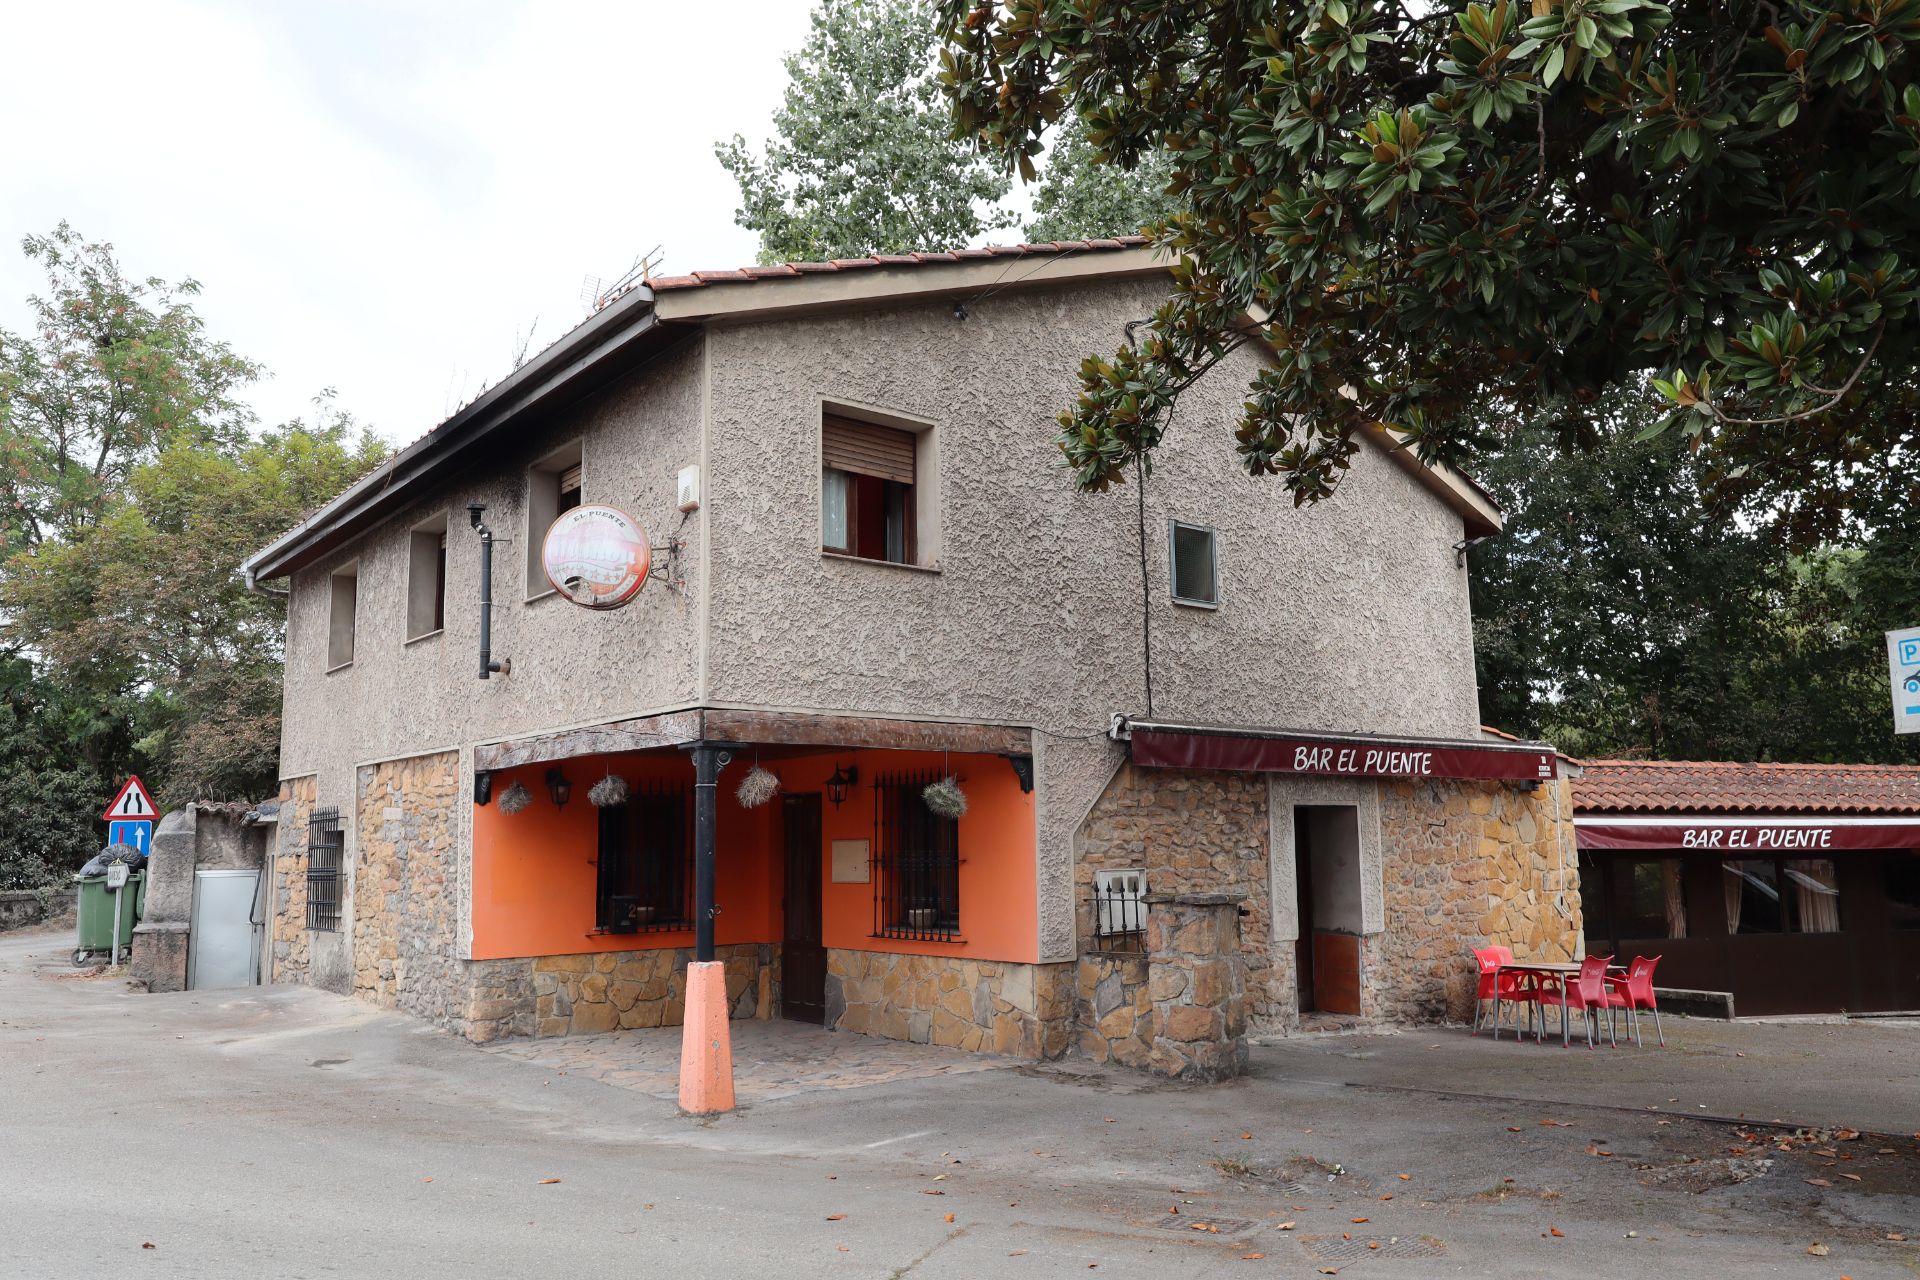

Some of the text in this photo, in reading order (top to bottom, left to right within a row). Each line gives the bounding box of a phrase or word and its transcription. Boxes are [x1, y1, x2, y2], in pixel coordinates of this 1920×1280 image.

[573, 510, 626, 528] EL PUENTE
[1905, 644, 1917, 660] P
[1293, 746, 1432, 775] BAR EL PUENTE
[1682, 829, 1832, 848] BAR EL PUENTE
[628, 903, 637, 918] 2
